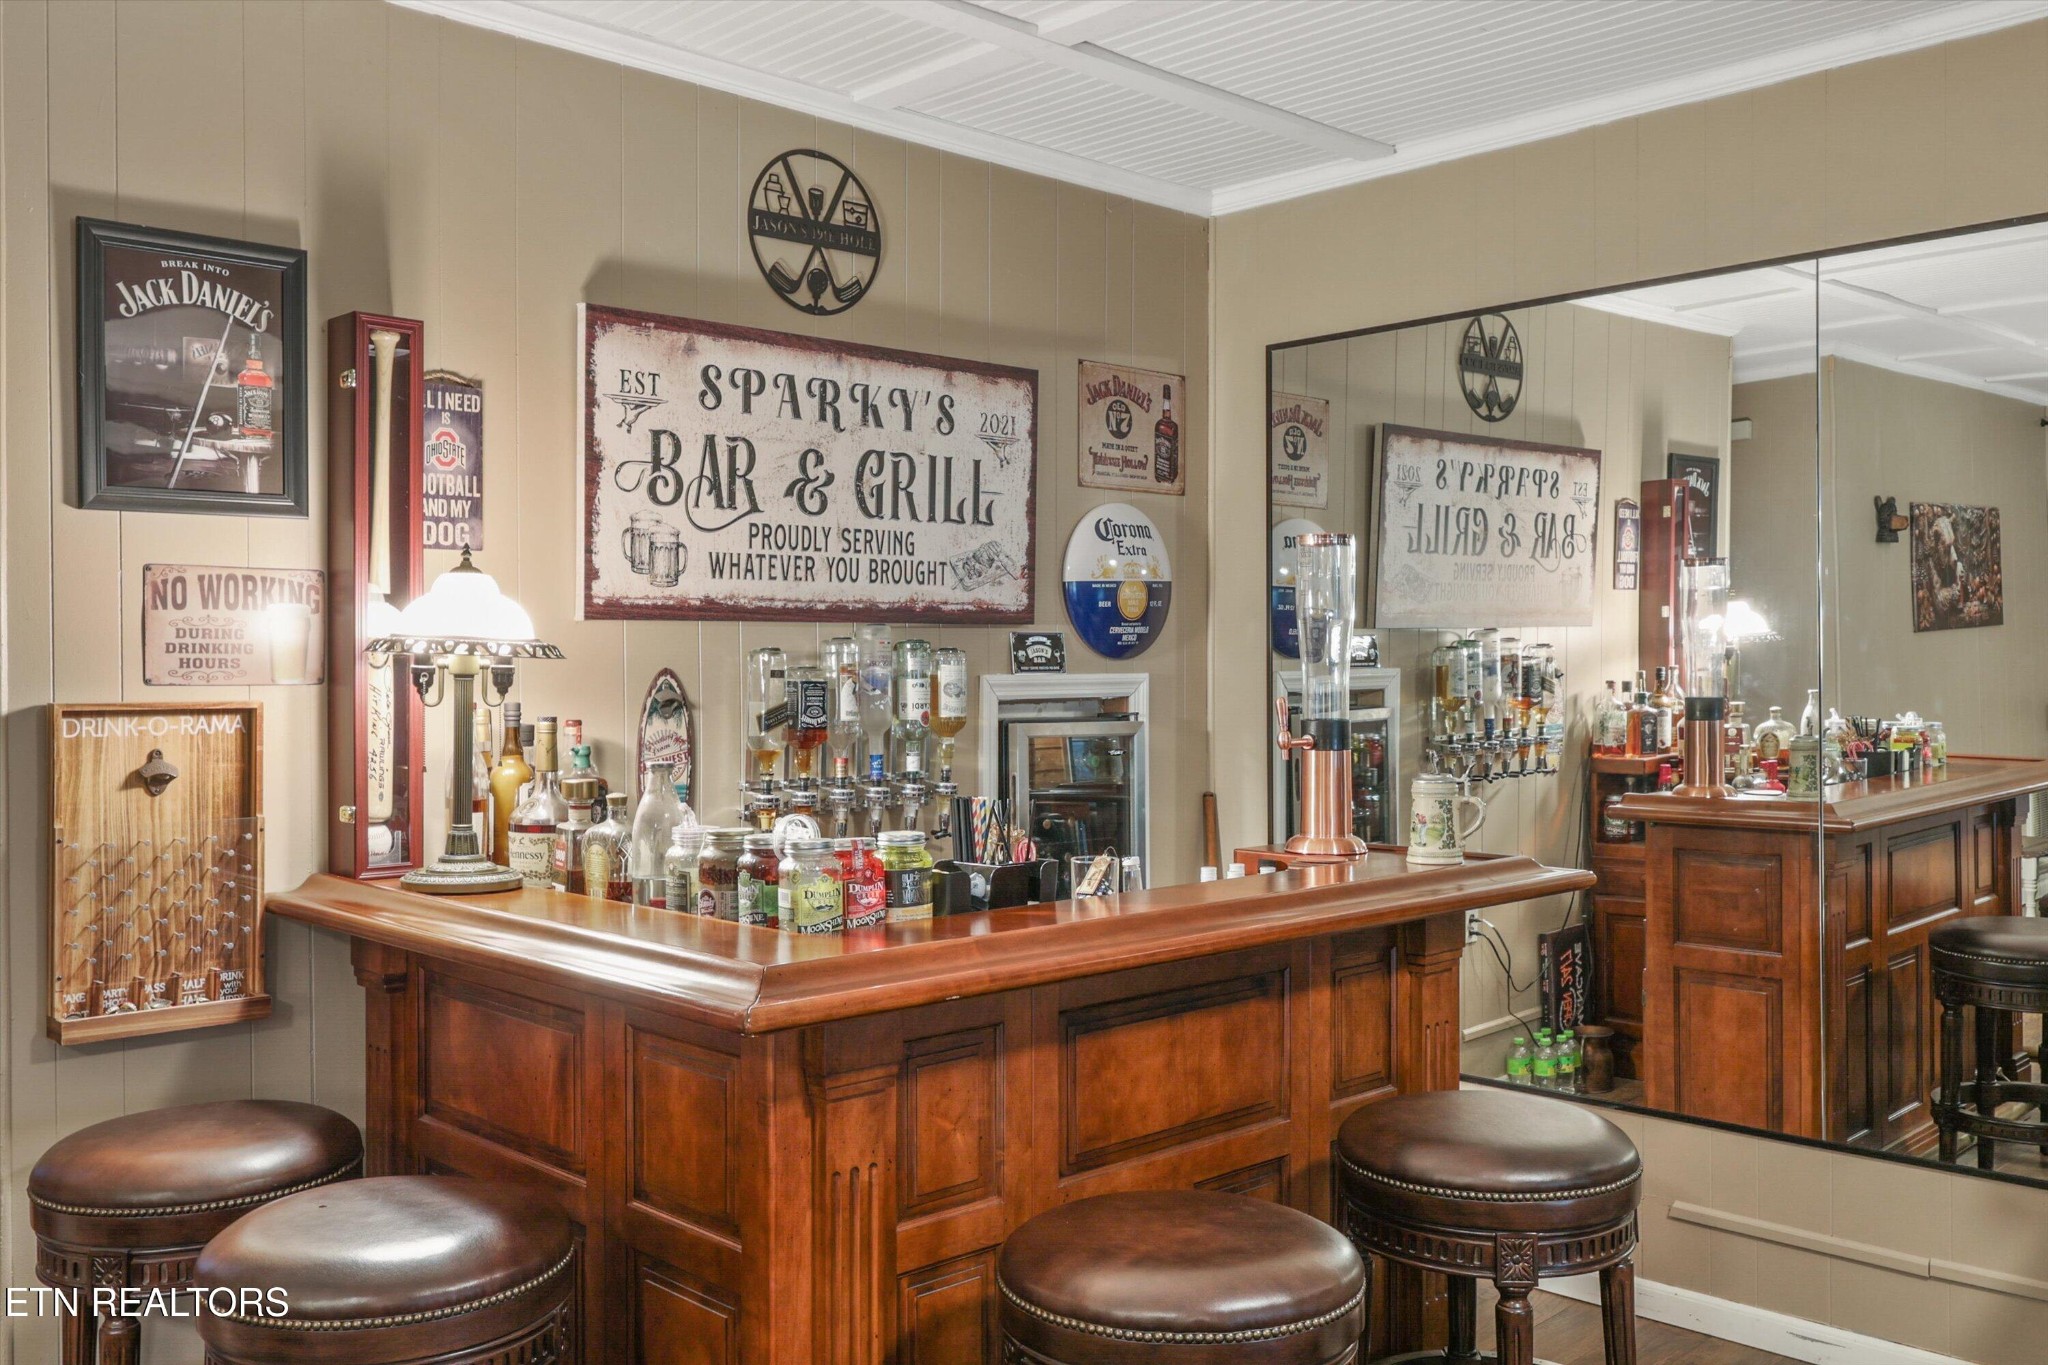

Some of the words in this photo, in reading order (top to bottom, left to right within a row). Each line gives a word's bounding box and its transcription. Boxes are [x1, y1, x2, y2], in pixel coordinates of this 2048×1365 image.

[161, 260, 199, 270] BREAK
[203, 263, 230, 277] INTO
[116, 278, 180, 317] JACK
[180, 270, 274, 333] DANIEL'S
[619, 368, 662, 398] EST
[1086, 379, 1113, 405] JACK
[1112, 375, 1152, 413] DANIEL'S
[445, 392, 481, 412] NEED
[700, 363, 956, 437] SPARKY'S
[1112, 402, 1126, 411] OLD
[442, 412, 451, 425] IS
[979, 411, 1017, 437] 2021
[614, 428, 764, 532] BAR
[783, 448, 835, 516] &
[854, 448, 1004, 527] GRILL
[451, 500, 472, 519] MY
[423, 521, 470, 546] DOG
[748, 523, 832, 553] PROUDLY
[840, 528, 915, 556] SERVING
[1094, 517, 1153, 544] Corona
[1117, 540, 1147, 556] Extra
[708, 551, 815, 582] WHATEVER
[826, 556, 859, 584] YOU
[868, 558, 948, 587] BROUGHT
[151, 576, 188, 611] NO
[198, 573, 320, 615] WORKING
[175, 627, 244, 640] DURING
[165, 642, 253, 655] DRINKING
[179, 657, 241, 669] HOURS
[61, 714, 247, 739] DRINK-O-RAMA
[804, 887, 841, 900] DUMPLIN
